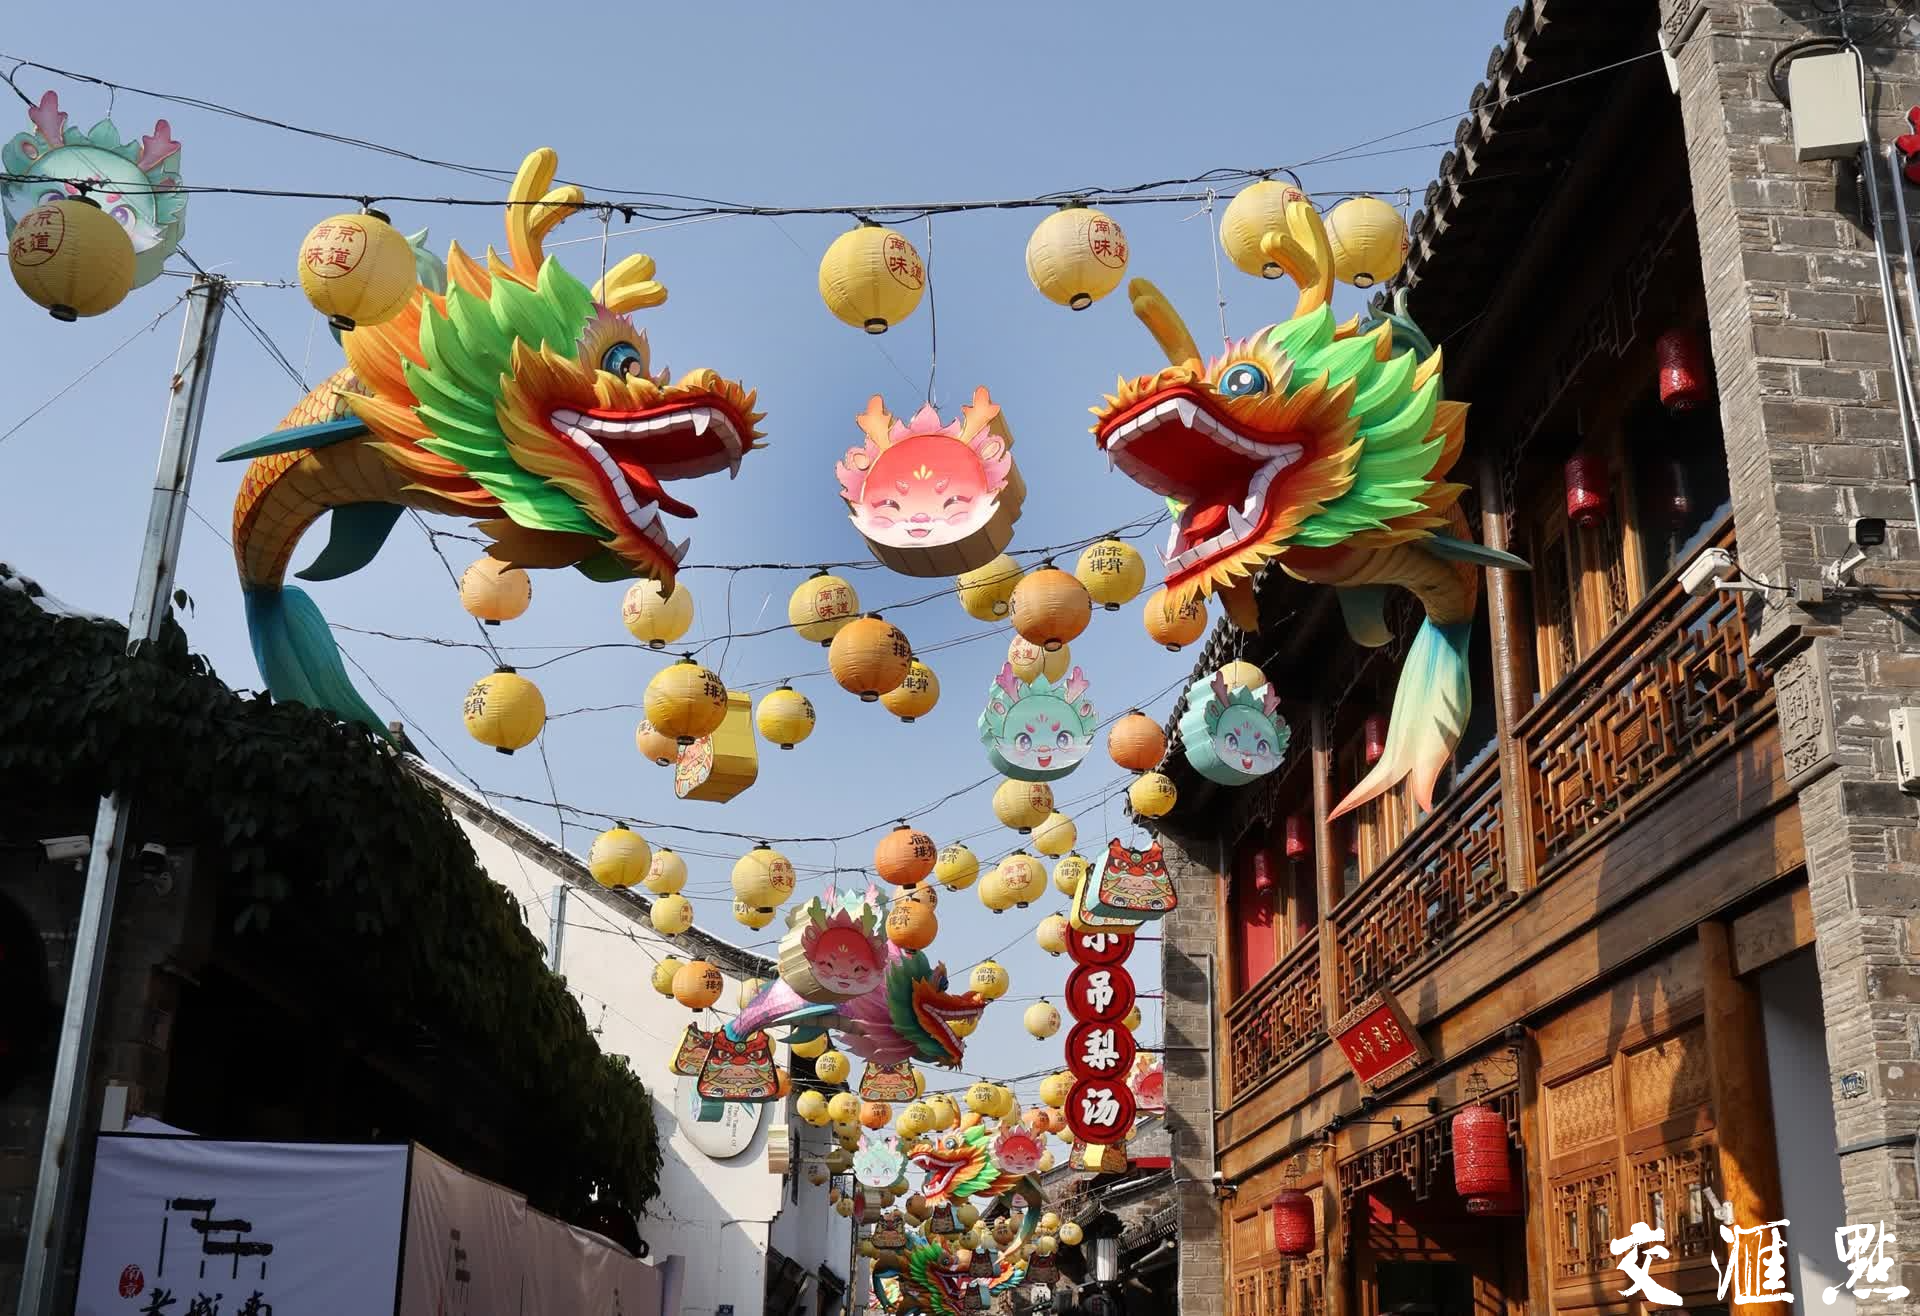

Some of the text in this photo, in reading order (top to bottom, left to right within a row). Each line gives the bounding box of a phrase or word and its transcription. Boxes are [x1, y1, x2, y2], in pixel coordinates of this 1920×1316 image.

[313, 224, 361, 243] 南京
[307, 247, 352, 271] 味道
[1090, 558, 1123, 574] 排骨
[819, 587, 847, 602] 南京
[820, 602, 848, 617] 味道
[1081, 932, 1121, 1127] 小吊梨汤
